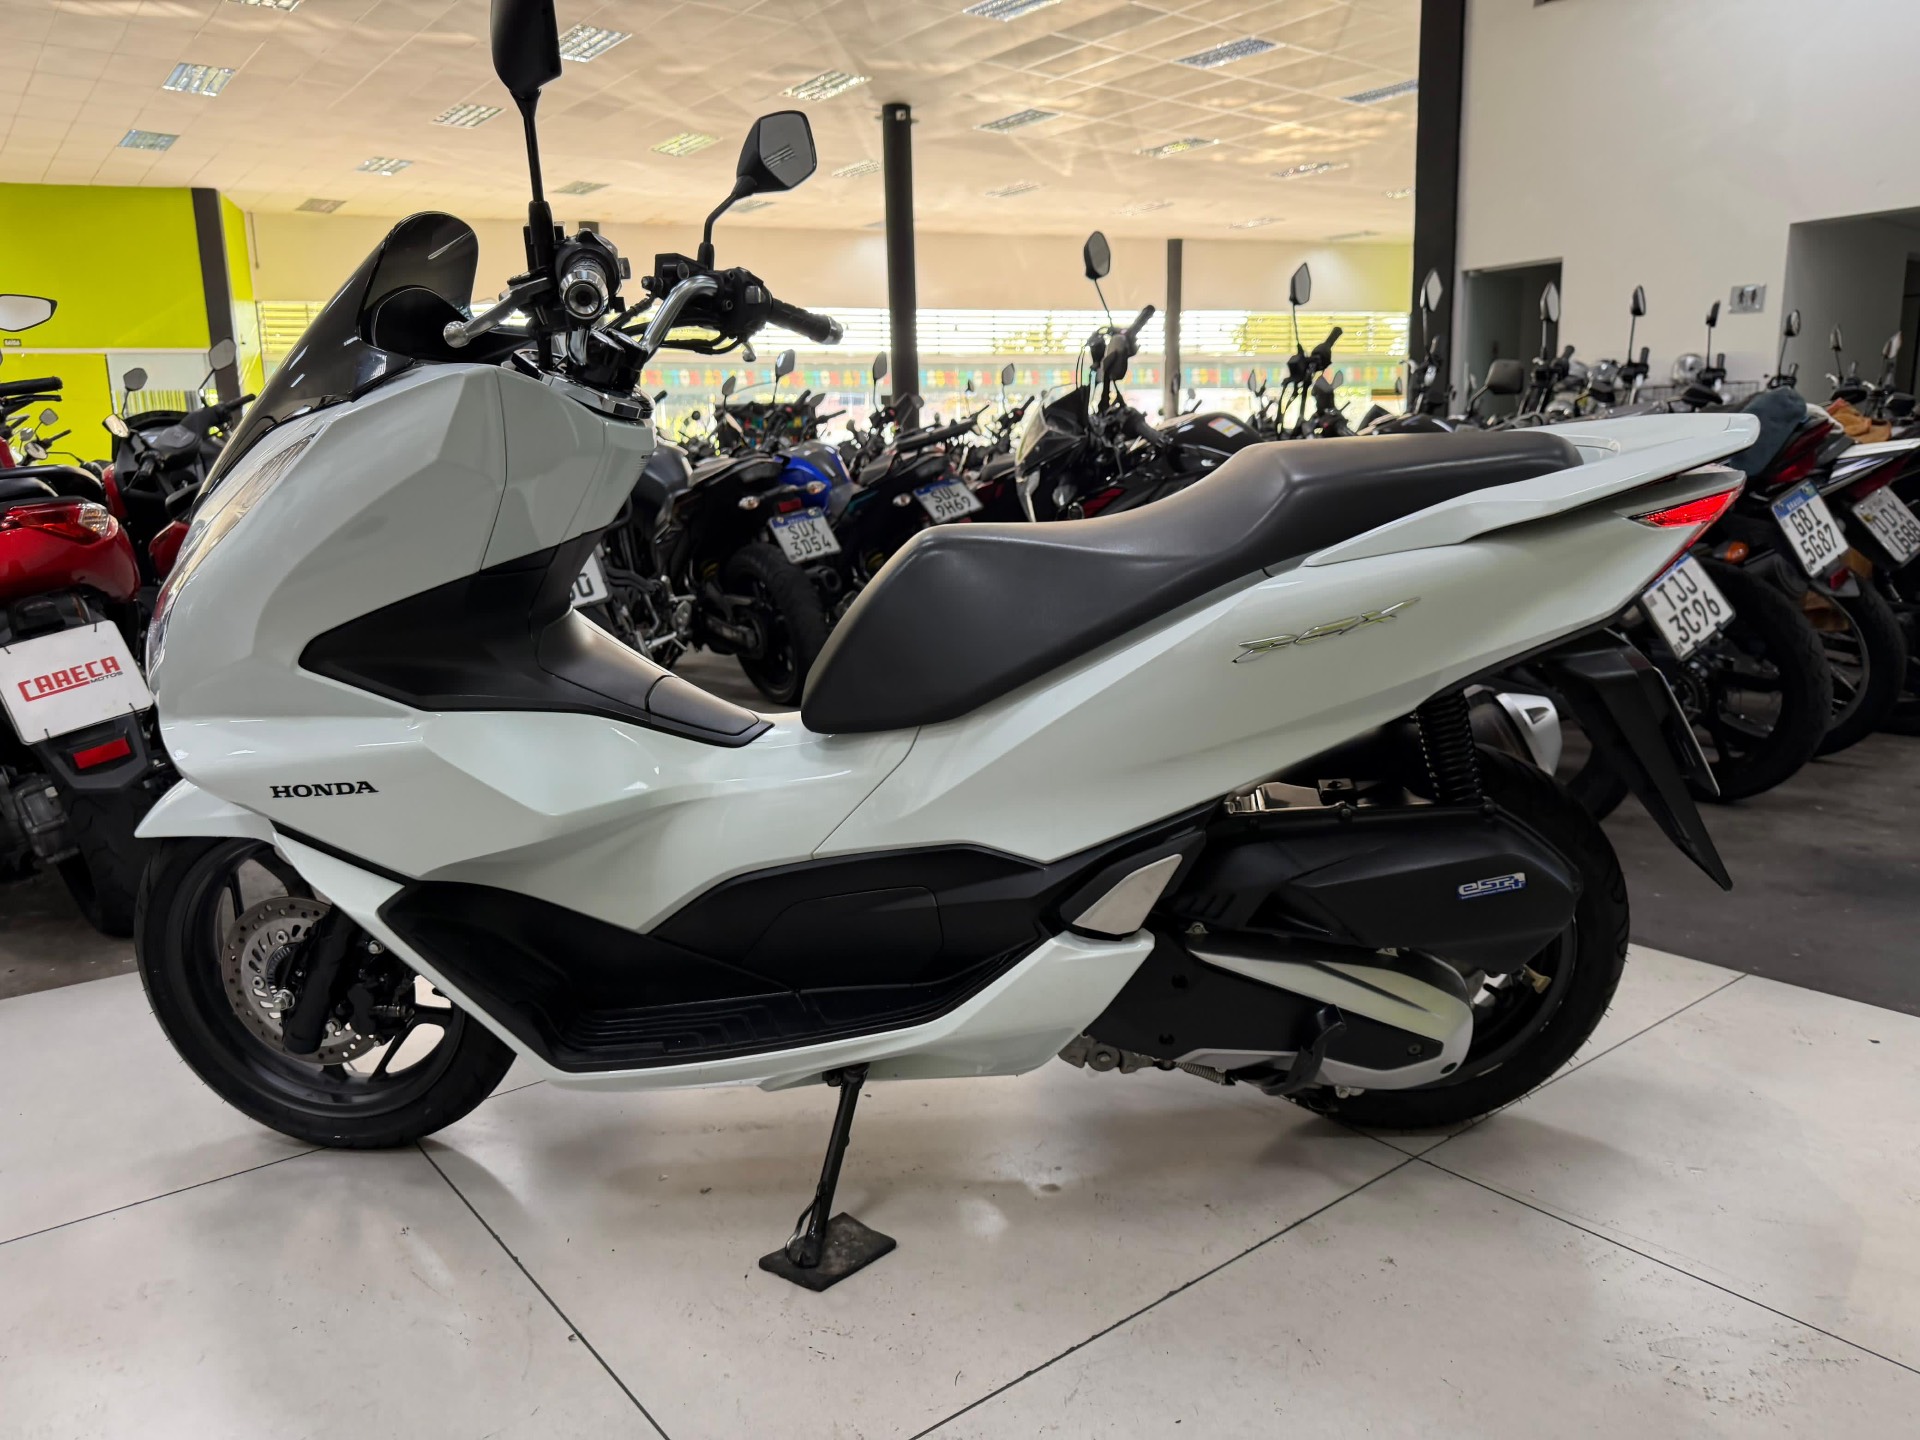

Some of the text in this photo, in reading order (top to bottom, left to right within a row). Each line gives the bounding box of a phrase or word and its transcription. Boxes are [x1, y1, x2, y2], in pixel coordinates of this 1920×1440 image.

[931, 486, 960, 503] SUL
[935, 496, 971, 517] 9H69
[788, 520, 820, 540] SUX
[1789, 502, 1822, 537] GBI
[790, 534, 832, 557] 3D54
[1800, 523, 1837, 565] 5G87
[1656, 567, 1698, 611] TJJ
[1668, 590, 1721, 643] 3C96
[17, 656, 121, 702] CARECA
[90, 670, 124, 684] MOTOS
[269, 780, 379, 798] HONDA
